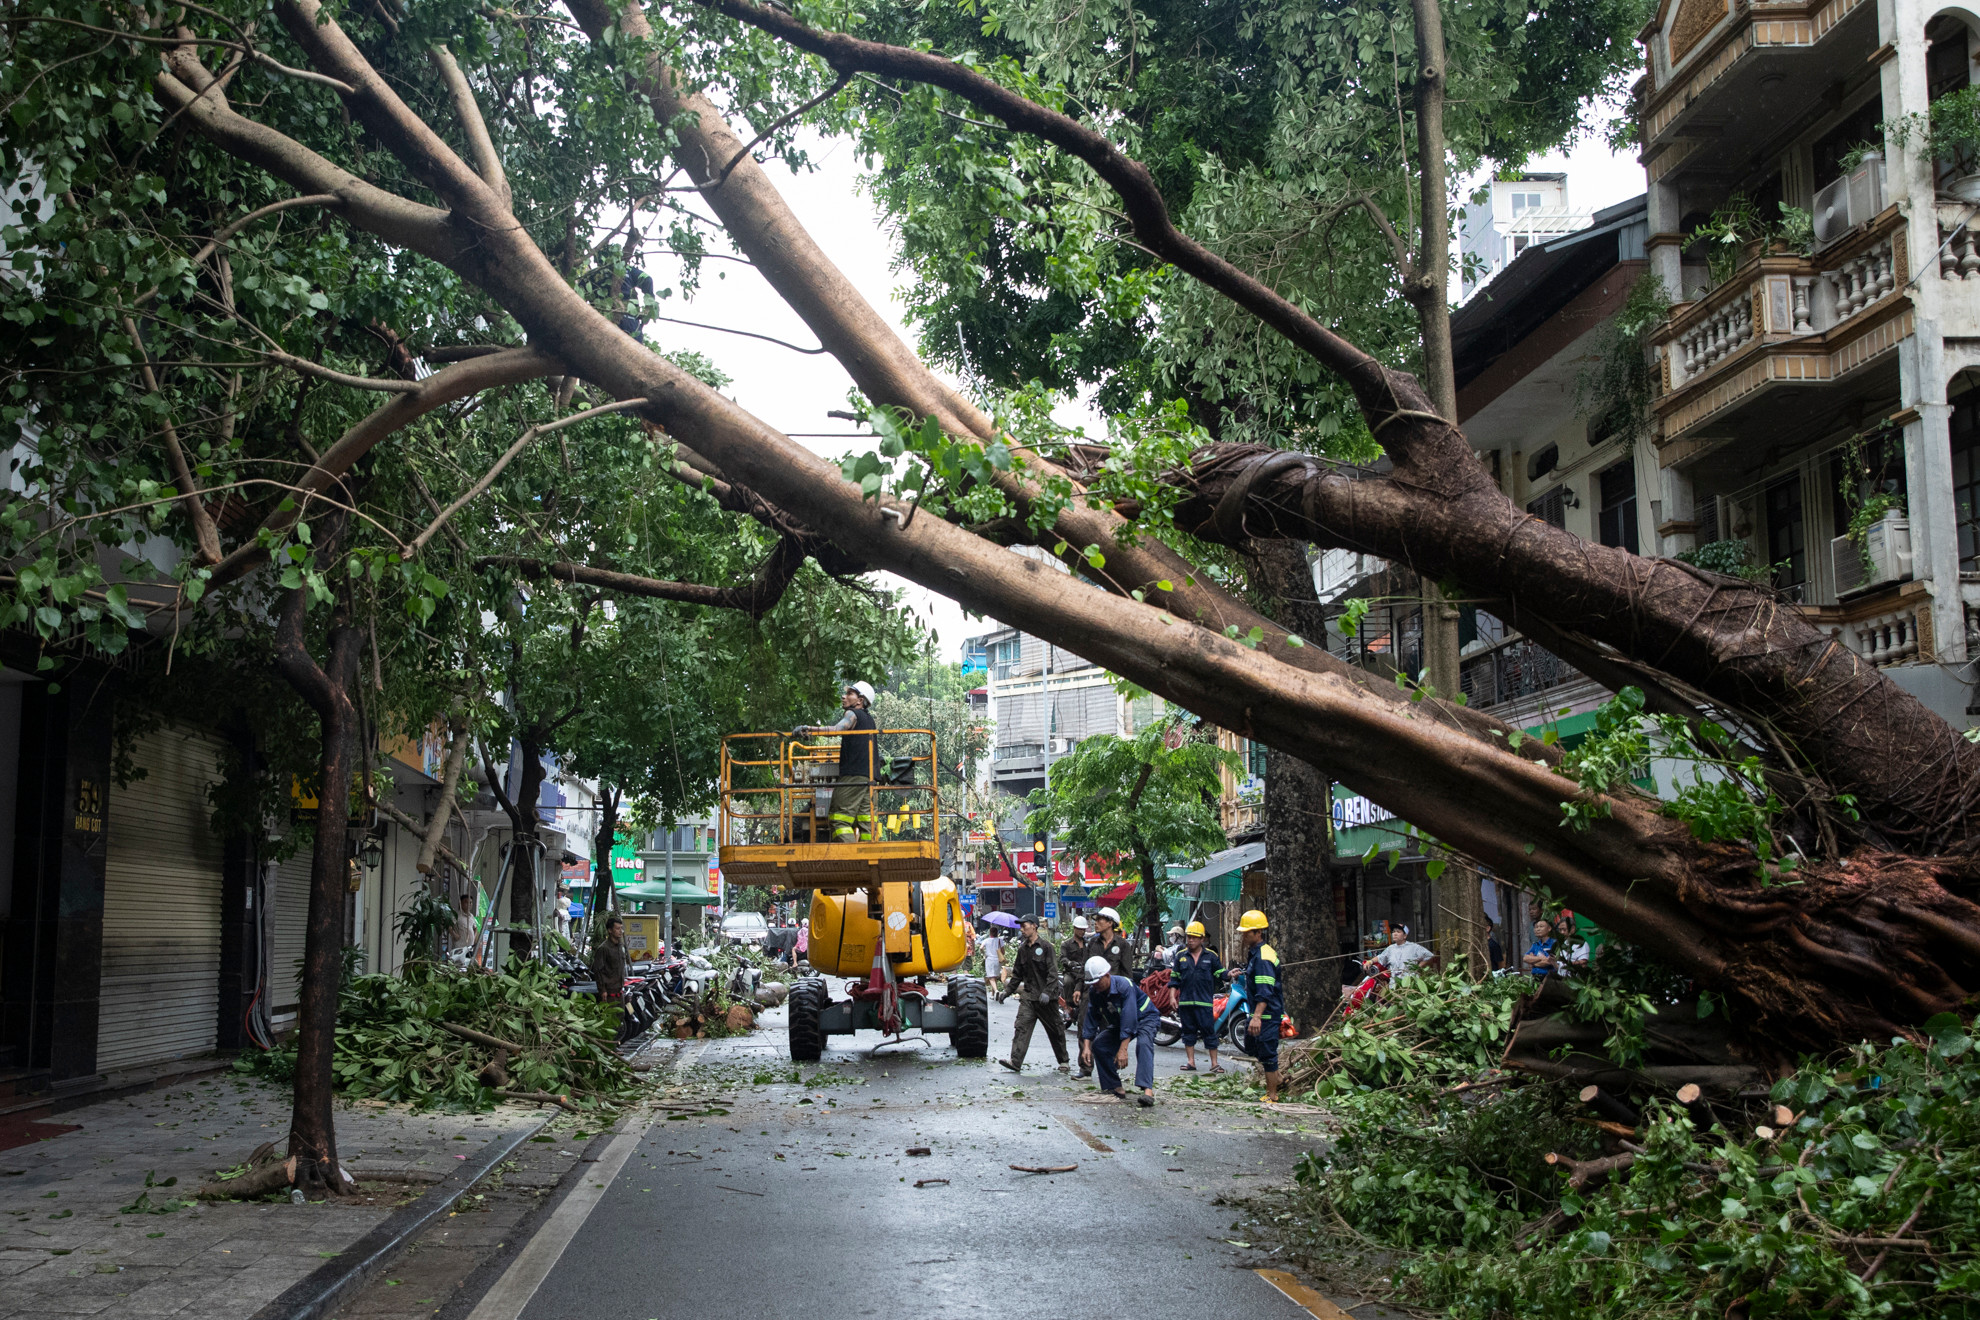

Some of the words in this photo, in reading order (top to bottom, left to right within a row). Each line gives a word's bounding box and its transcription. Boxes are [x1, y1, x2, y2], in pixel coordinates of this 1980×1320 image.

[79, 780, 103, 814] 59
[1344, 796, 1370, 828] BEN
[615, 857, 633, 869] Hoa
